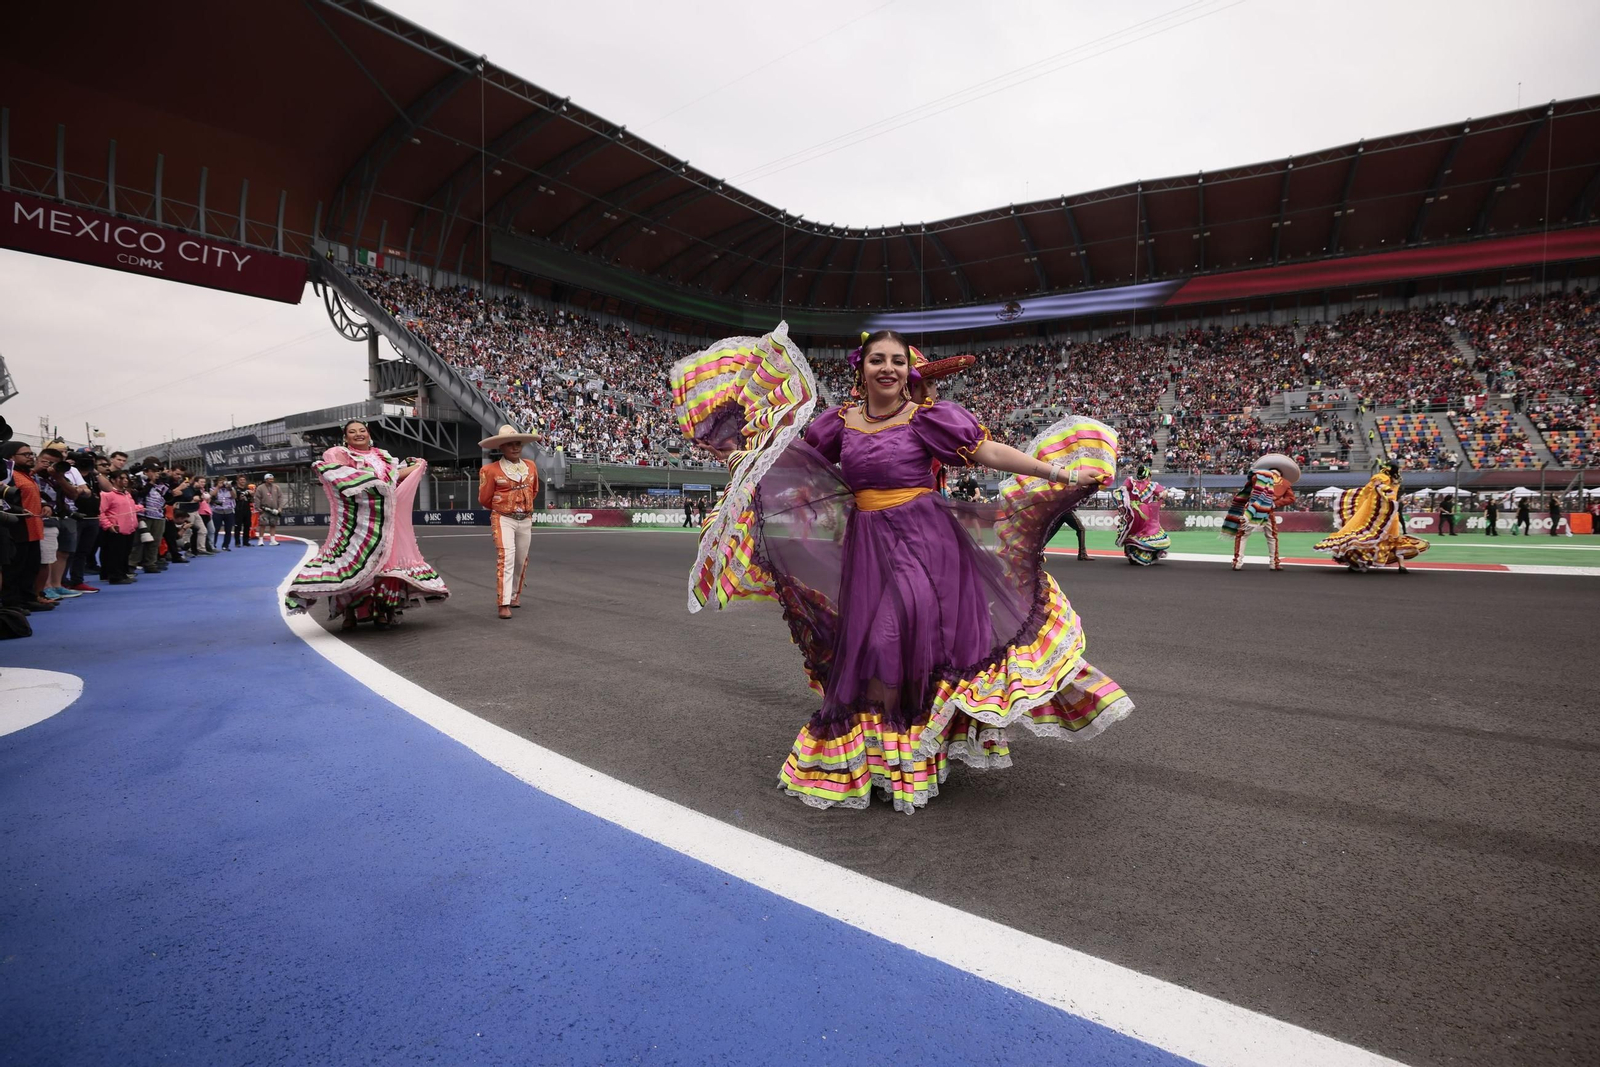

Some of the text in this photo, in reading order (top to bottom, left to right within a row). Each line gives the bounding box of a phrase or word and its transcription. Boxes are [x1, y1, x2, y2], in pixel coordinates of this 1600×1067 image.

[13, 201, 252, 272] MEXICO CITY
[116, 252, 164, 271] CDMX
[209, 449, 226, 465] MSC
[262, 453, 272, 461] MSC
[280, 450, 290, 459] MSC
[298, 448, 310, 458] MSC
[230, 456, 240, 464] MSC
[246, 454, 256, 463] MSC
[306, 515, 315, 523] MSC
[429, 513, 442, 521] MSC
[461, 512, 475, 521] MSC
